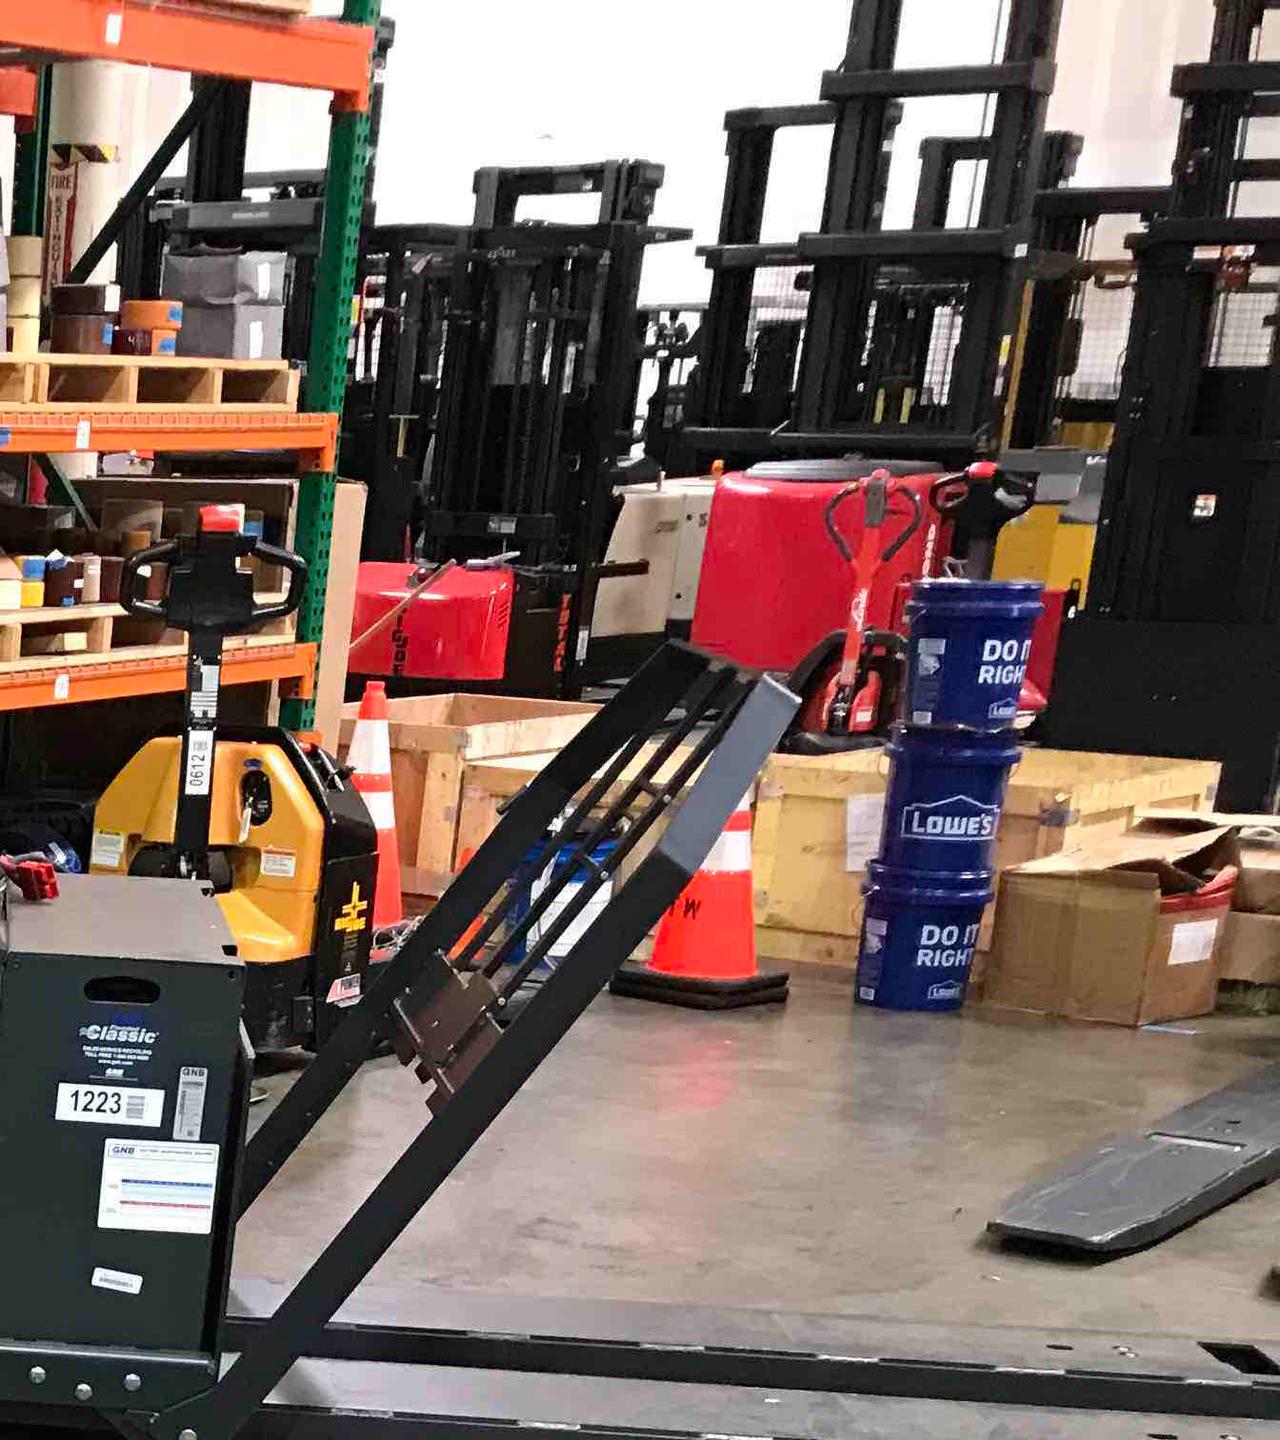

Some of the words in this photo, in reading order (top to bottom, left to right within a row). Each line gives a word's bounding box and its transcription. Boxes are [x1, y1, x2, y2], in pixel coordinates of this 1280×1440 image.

[51, 174, 71, 189] FIRE
[981, 639, 1018, 662] DO
[189, 753, 206, 787] 0612
[920, 924, 960, 946] DO
[86, 1025, 157, 1044] Classic
[70, 1089, 122, 1115] 1223
